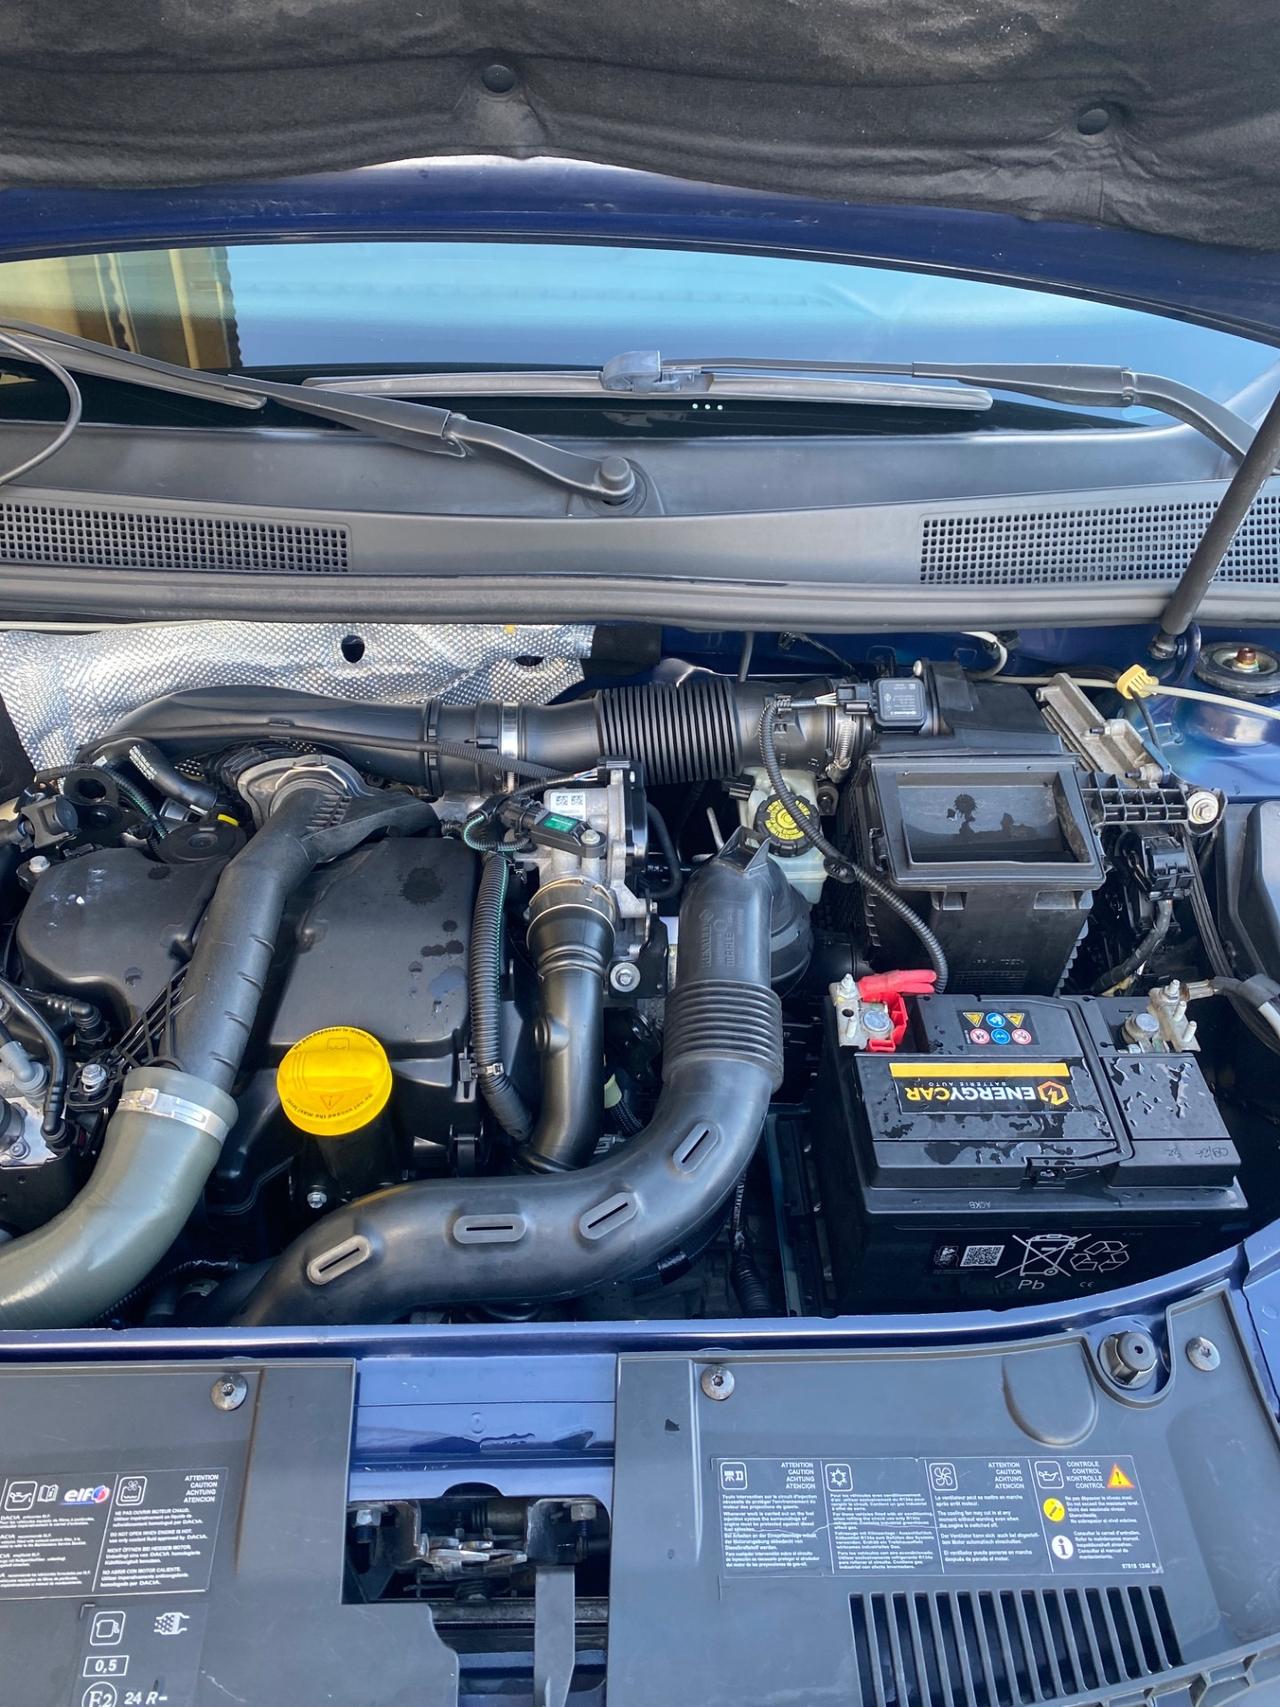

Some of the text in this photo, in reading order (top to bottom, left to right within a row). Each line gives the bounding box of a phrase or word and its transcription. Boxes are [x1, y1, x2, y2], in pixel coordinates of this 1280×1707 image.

[905, 1087, 1037, 1101] ENERGYCAR
[1018, 1279, 1045, 1290] Pb
[190, 1481, 218, 1489] CAUTION
[95, 1659, 117, 1674] 0,5
[124, 1692, 142, 1705] 24
